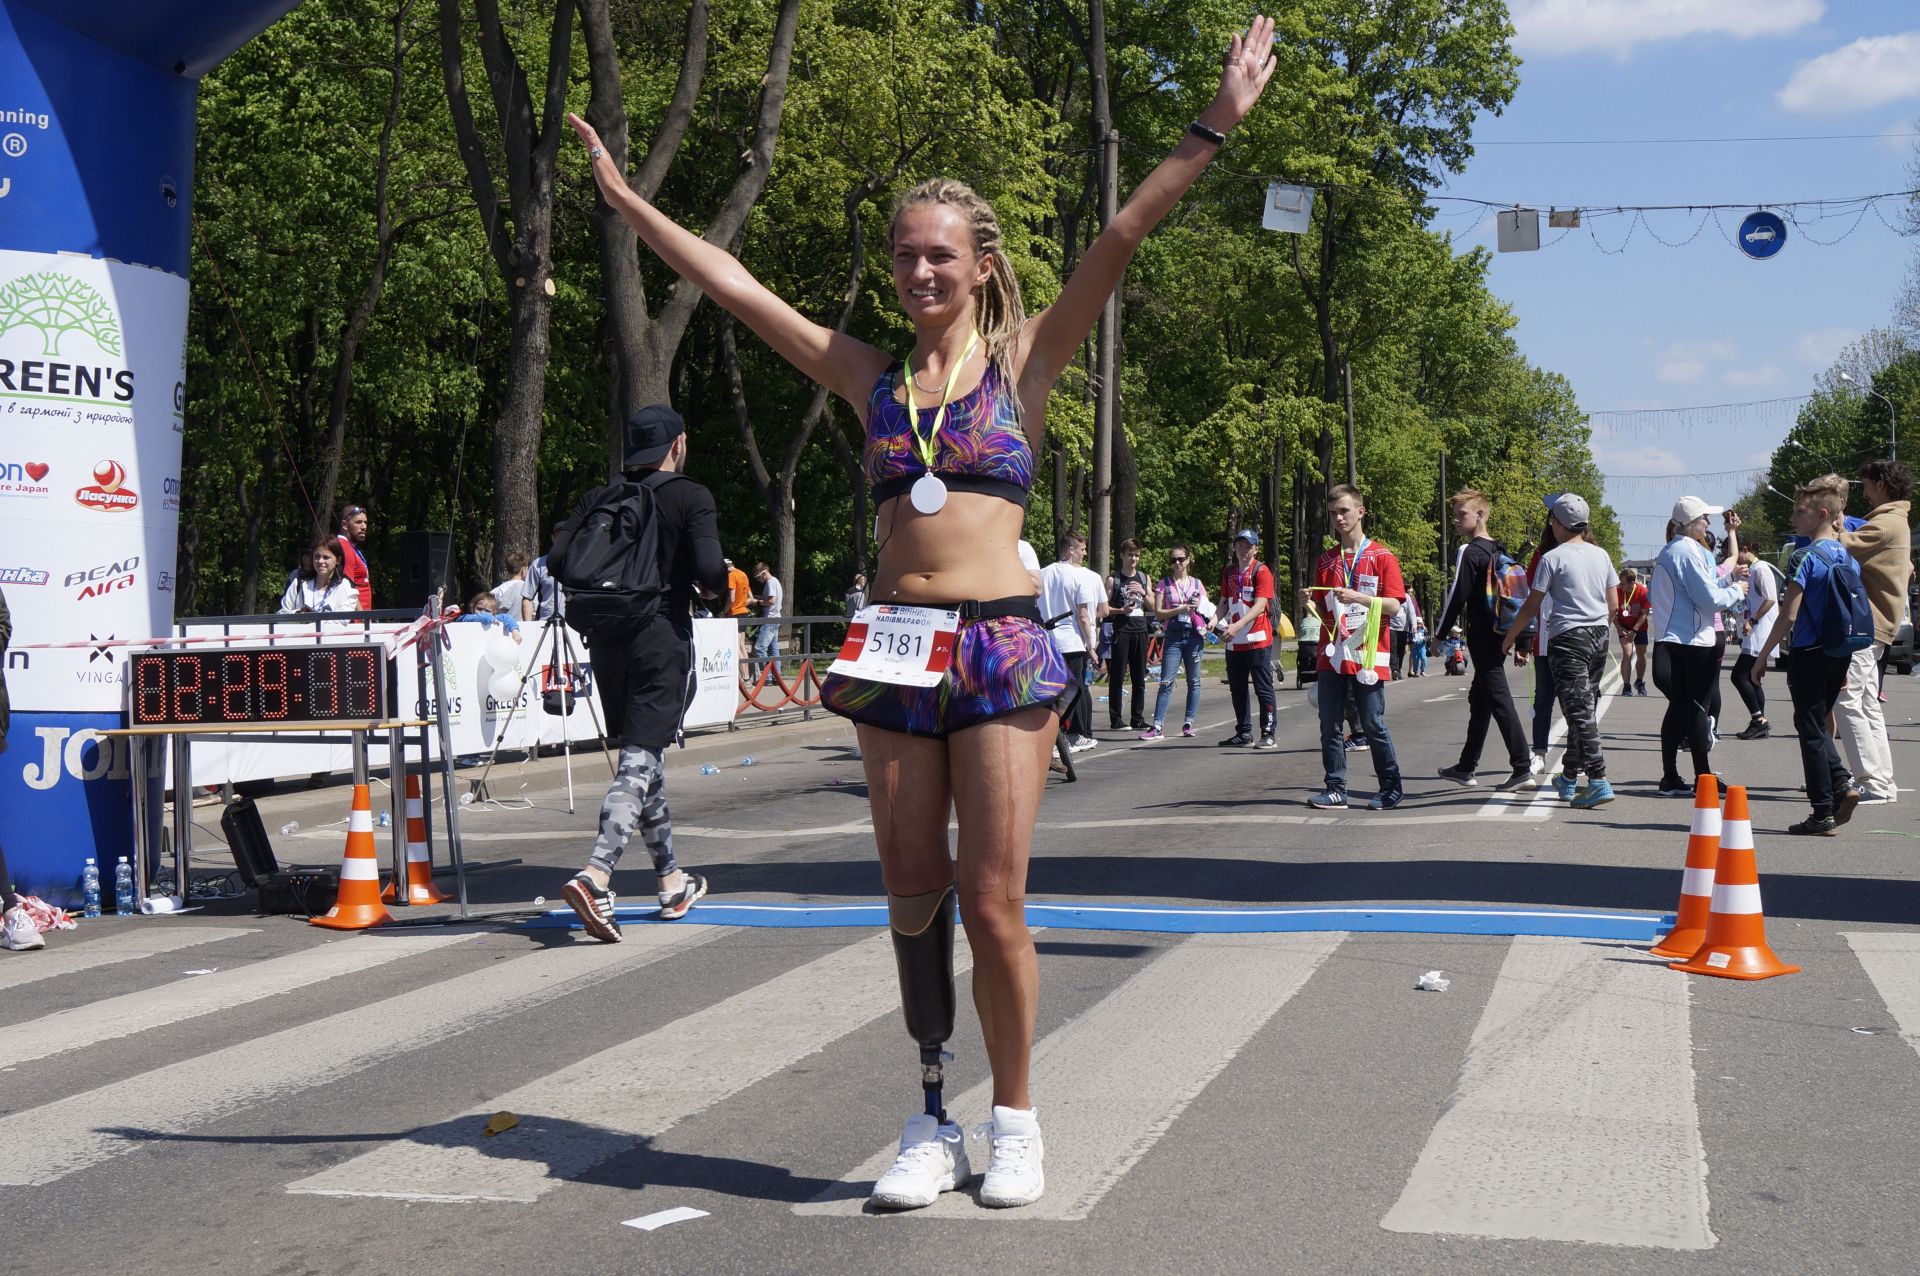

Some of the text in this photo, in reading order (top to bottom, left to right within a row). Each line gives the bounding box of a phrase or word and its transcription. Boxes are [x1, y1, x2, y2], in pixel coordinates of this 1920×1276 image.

[15, 484, 48, 493] Japan
[875, 615, 932, 626] НАПІВМАРАФОН
[869, 632, 922, 656] 5181
[76, 671, 124, 684] VINGA
[138, 650, 376, 722] 02:29:17
